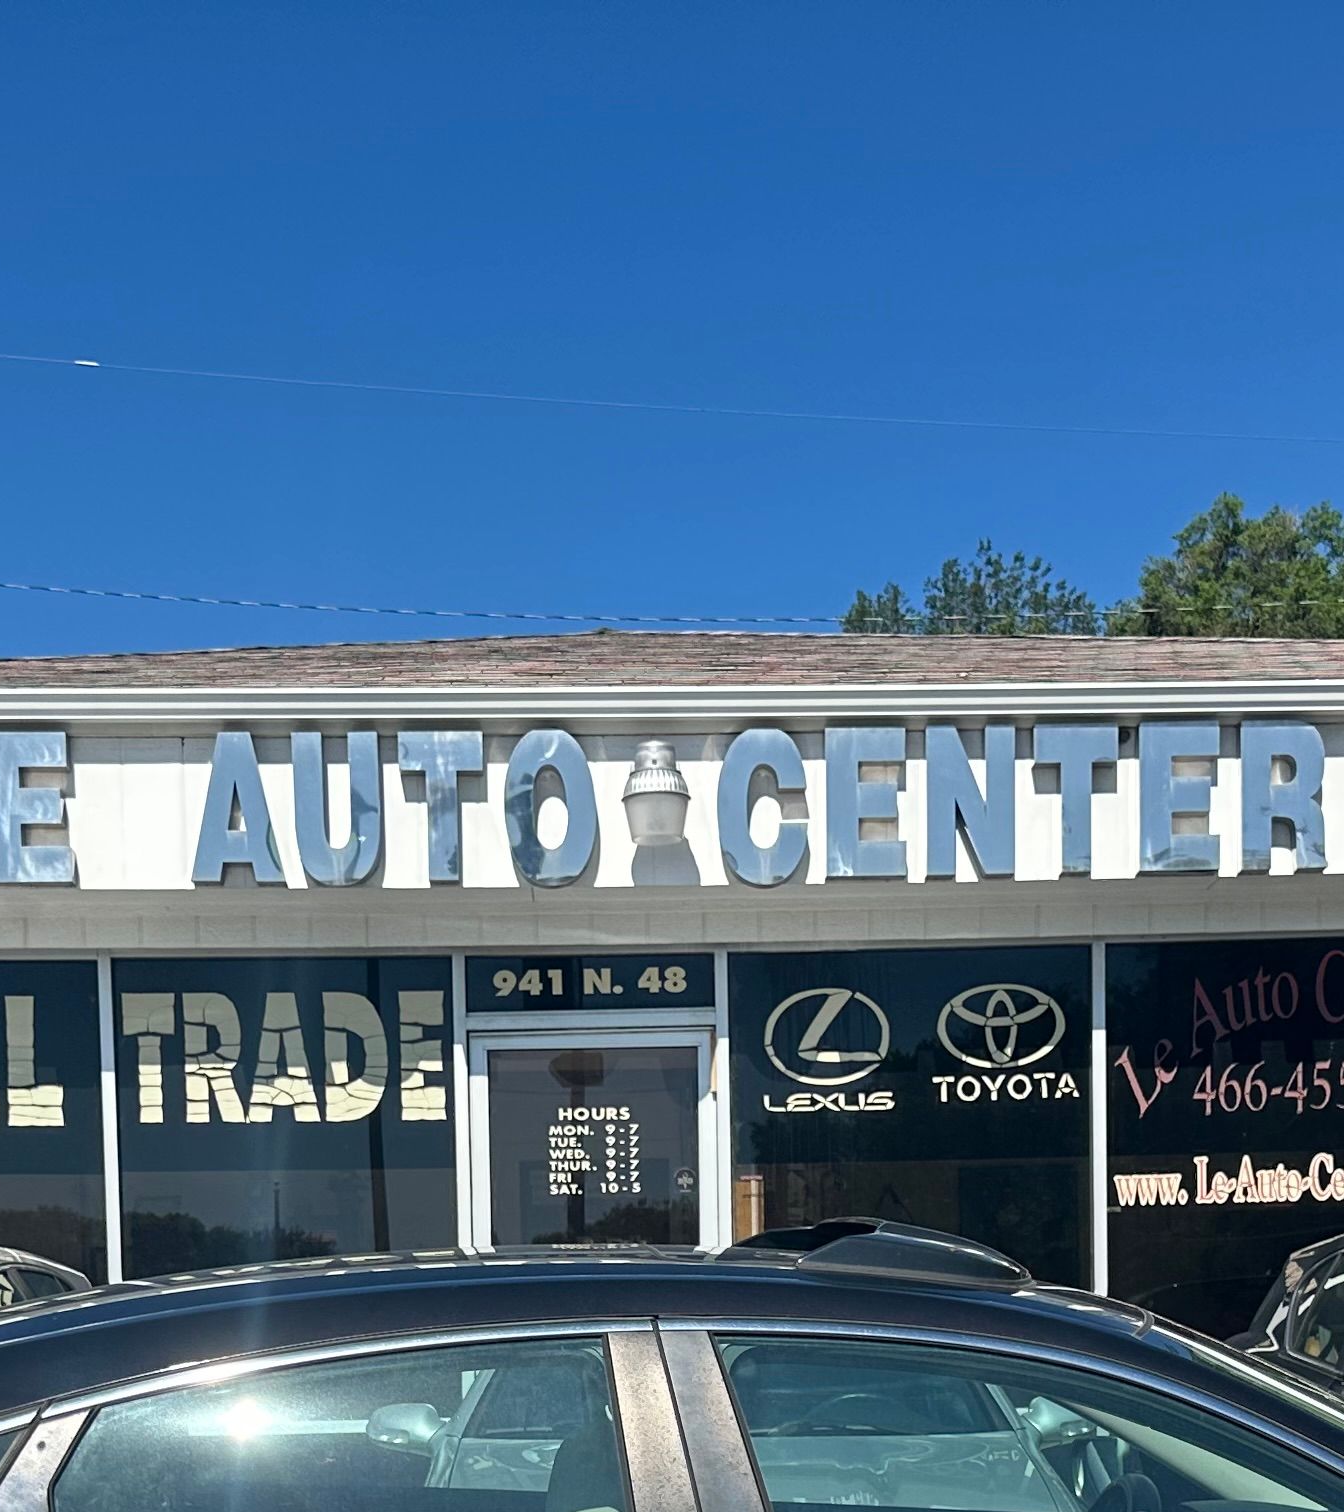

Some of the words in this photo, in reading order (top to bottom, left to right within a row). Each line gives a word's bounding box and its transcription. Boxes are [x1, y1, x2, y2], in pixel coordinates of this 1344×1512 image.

[192, 728, 599, 888] AUTO
[718, 720, 1327, 887] CENTER
[492, 969, 564, 997] 941
[583, 967, 624, 995] N.
[637, 966, 688, 993] 48
[1114, 1038, 1179, 1119] Le
[1190, 965, 1299, 1058] Auto
[121, 990, 447, 1125] TRADE
[932, 1072, 1080, 1102] TOYOTA
[762, 1090, 896, 1113] LEXUS
[558, 1107, 631, 1121] HOURS
[548, 1125, 595, 1136] MON.
[548, 1137, 582, 1148] TUE.
[548, 1149, 590, 1160] WED.
[549, 1160, 598, 1172] THUR.
[549, 1172, 572, 1183] FRI
[549, 1184, 584, 1196] SAT.
[1113, 1173, 1188, 1206] www.
